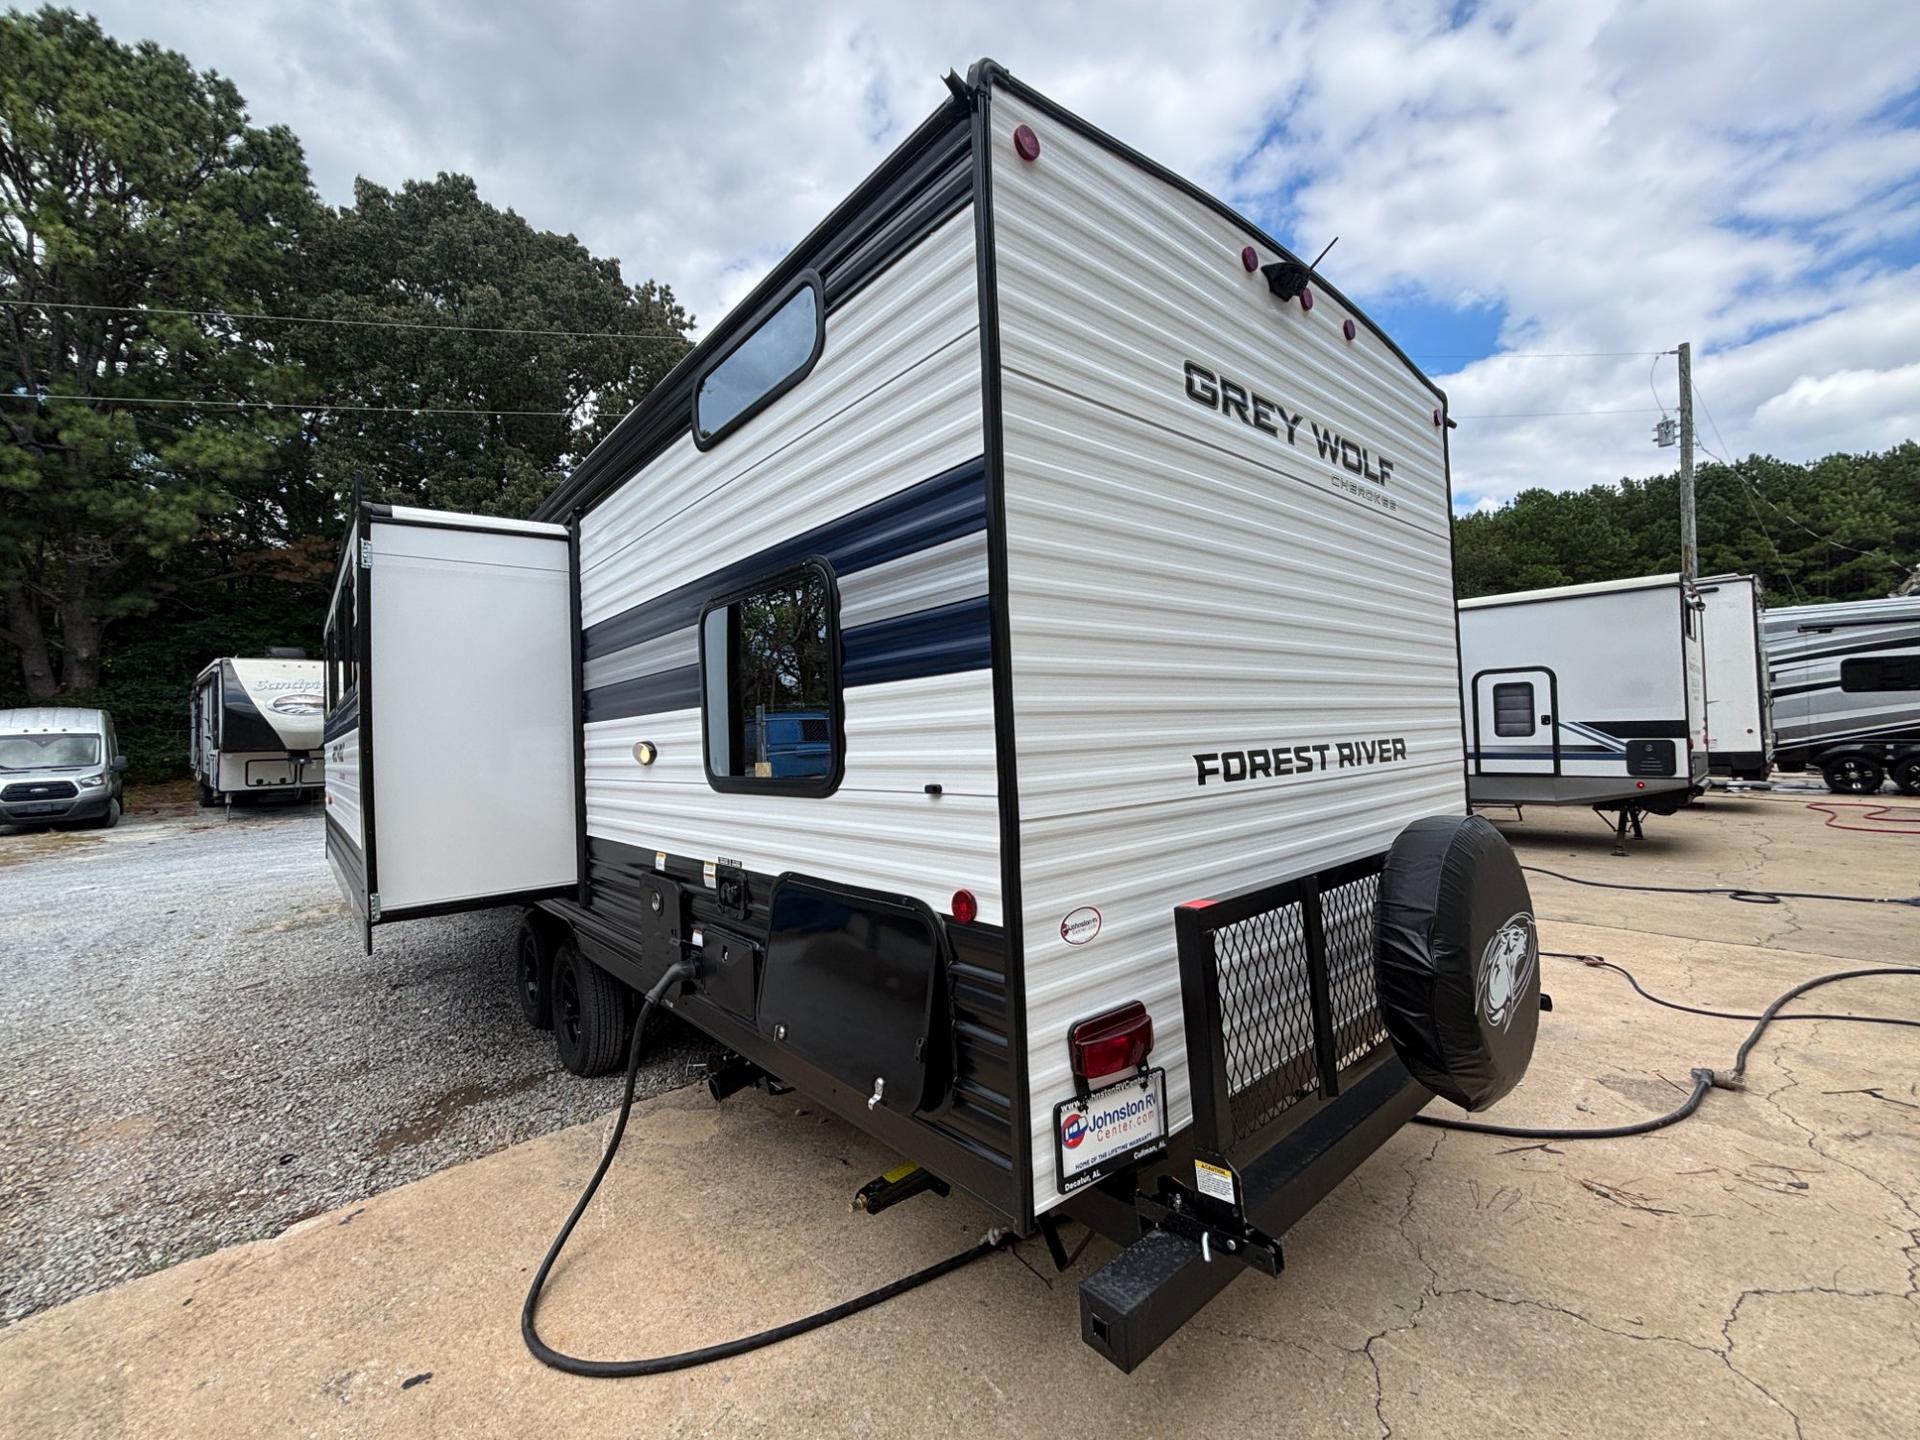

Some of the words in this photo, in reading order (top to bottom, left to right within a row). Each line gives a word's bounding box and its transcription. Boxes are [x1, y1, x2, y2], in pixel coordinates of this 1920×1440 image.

[1184, 359, 1303, 446] GREY
[1310, 421, 1394, 487] WOLF
[1331, 474, 1397, 511] CHEROKEE
[1192, 743, 1330, 786] FOREST
[1335, 738, 1407, 768] RIVER
[1088, 1098, 1145, 1132] Johnston
[1145, 1092, 1156, 1109] RV
[1097, 1111, 1154, 1141] Center.com
[1075, 1158, 1090, 1170] HOME
[1090, 1154, 1098, 1164] OF
[1098, 1150, 1108, 1161] THE
[1065, 1176, 1092, 1192] Decatur,
[1092, 1168, 1102, 1180] AL
